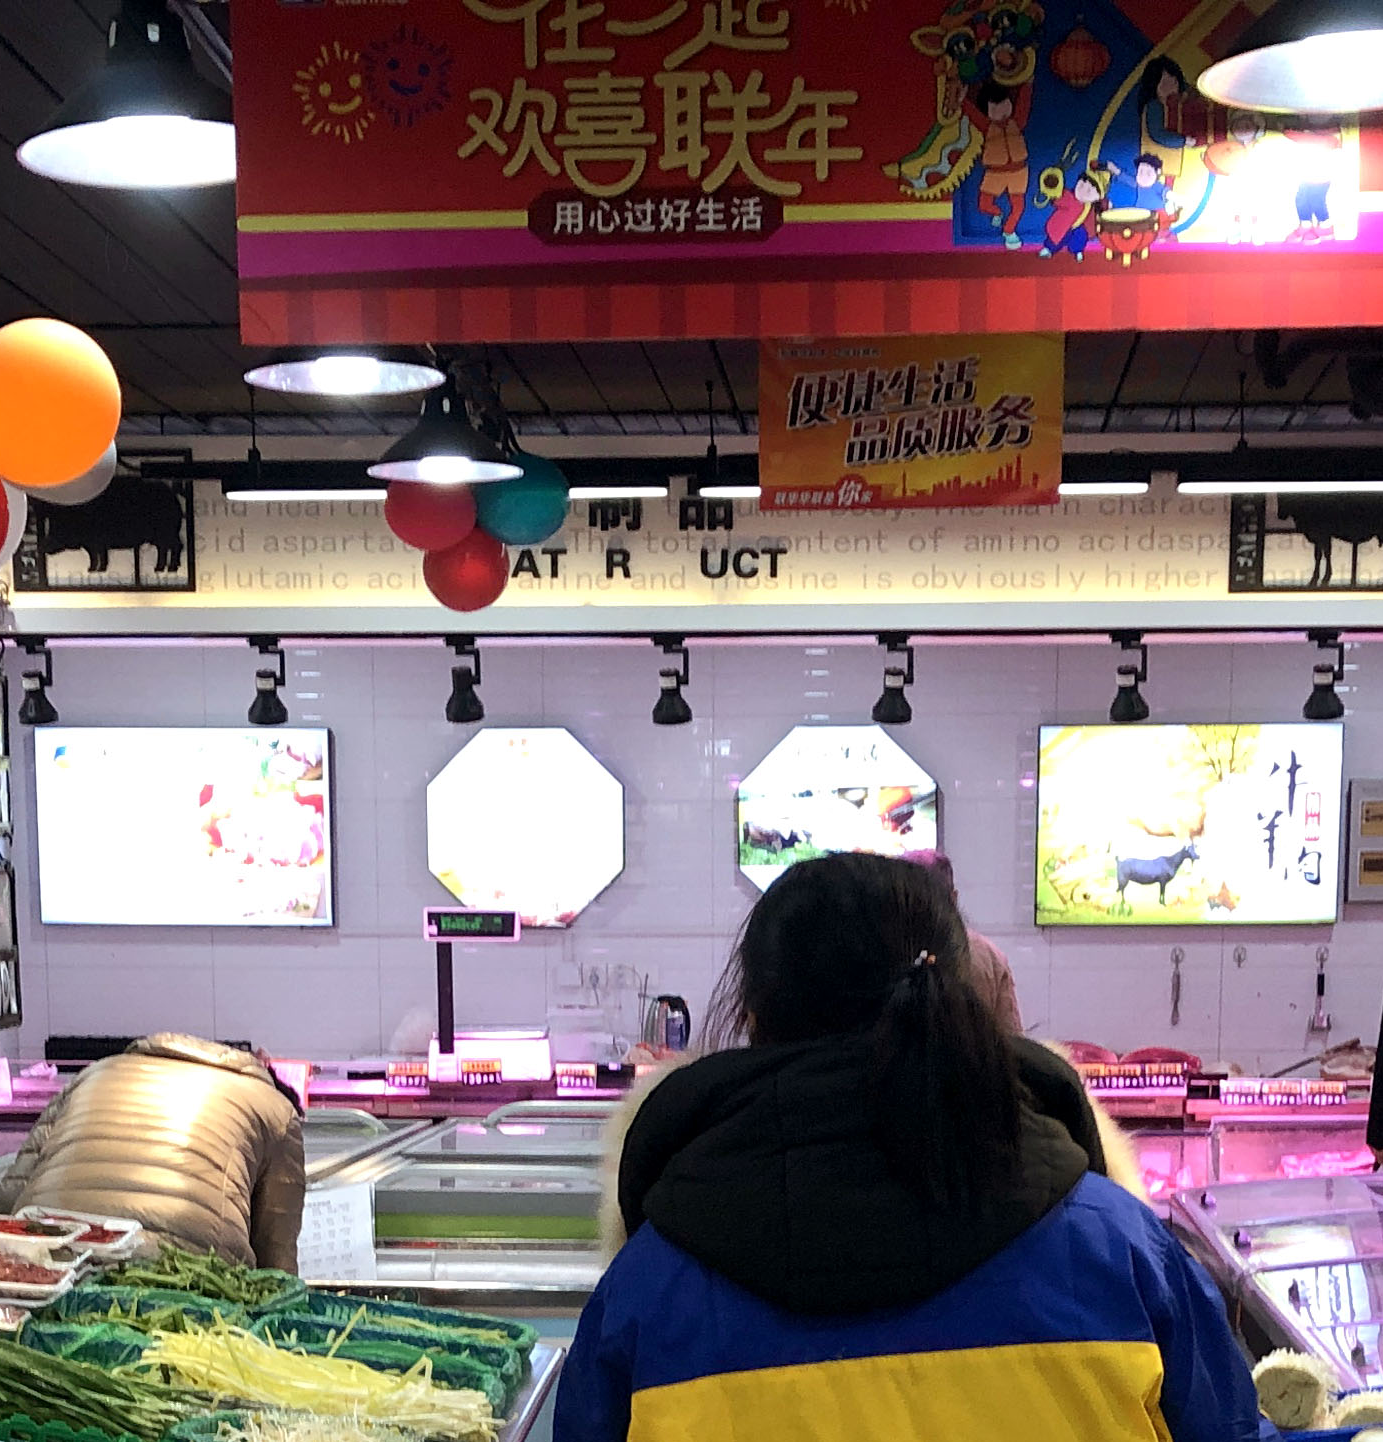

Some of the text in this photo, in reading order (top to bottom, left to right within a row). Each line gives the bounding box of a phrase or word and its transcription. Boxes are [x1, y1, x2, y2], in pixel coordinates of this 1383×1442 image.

[553, 196, 764, 235] 用心过好生活
[786, 354, 981, 431] 便捷生活
[844, 393, 1038, 468] 品质服务
[908, 528, 945, 553] of
[964, 529, 1060, 553] amino
[699, 546, 789, 580] UCT
[863, 564, 892, 590] is
[912, 563, 1086, 592] obviously
[1104, 563, 1219, 593] higher
